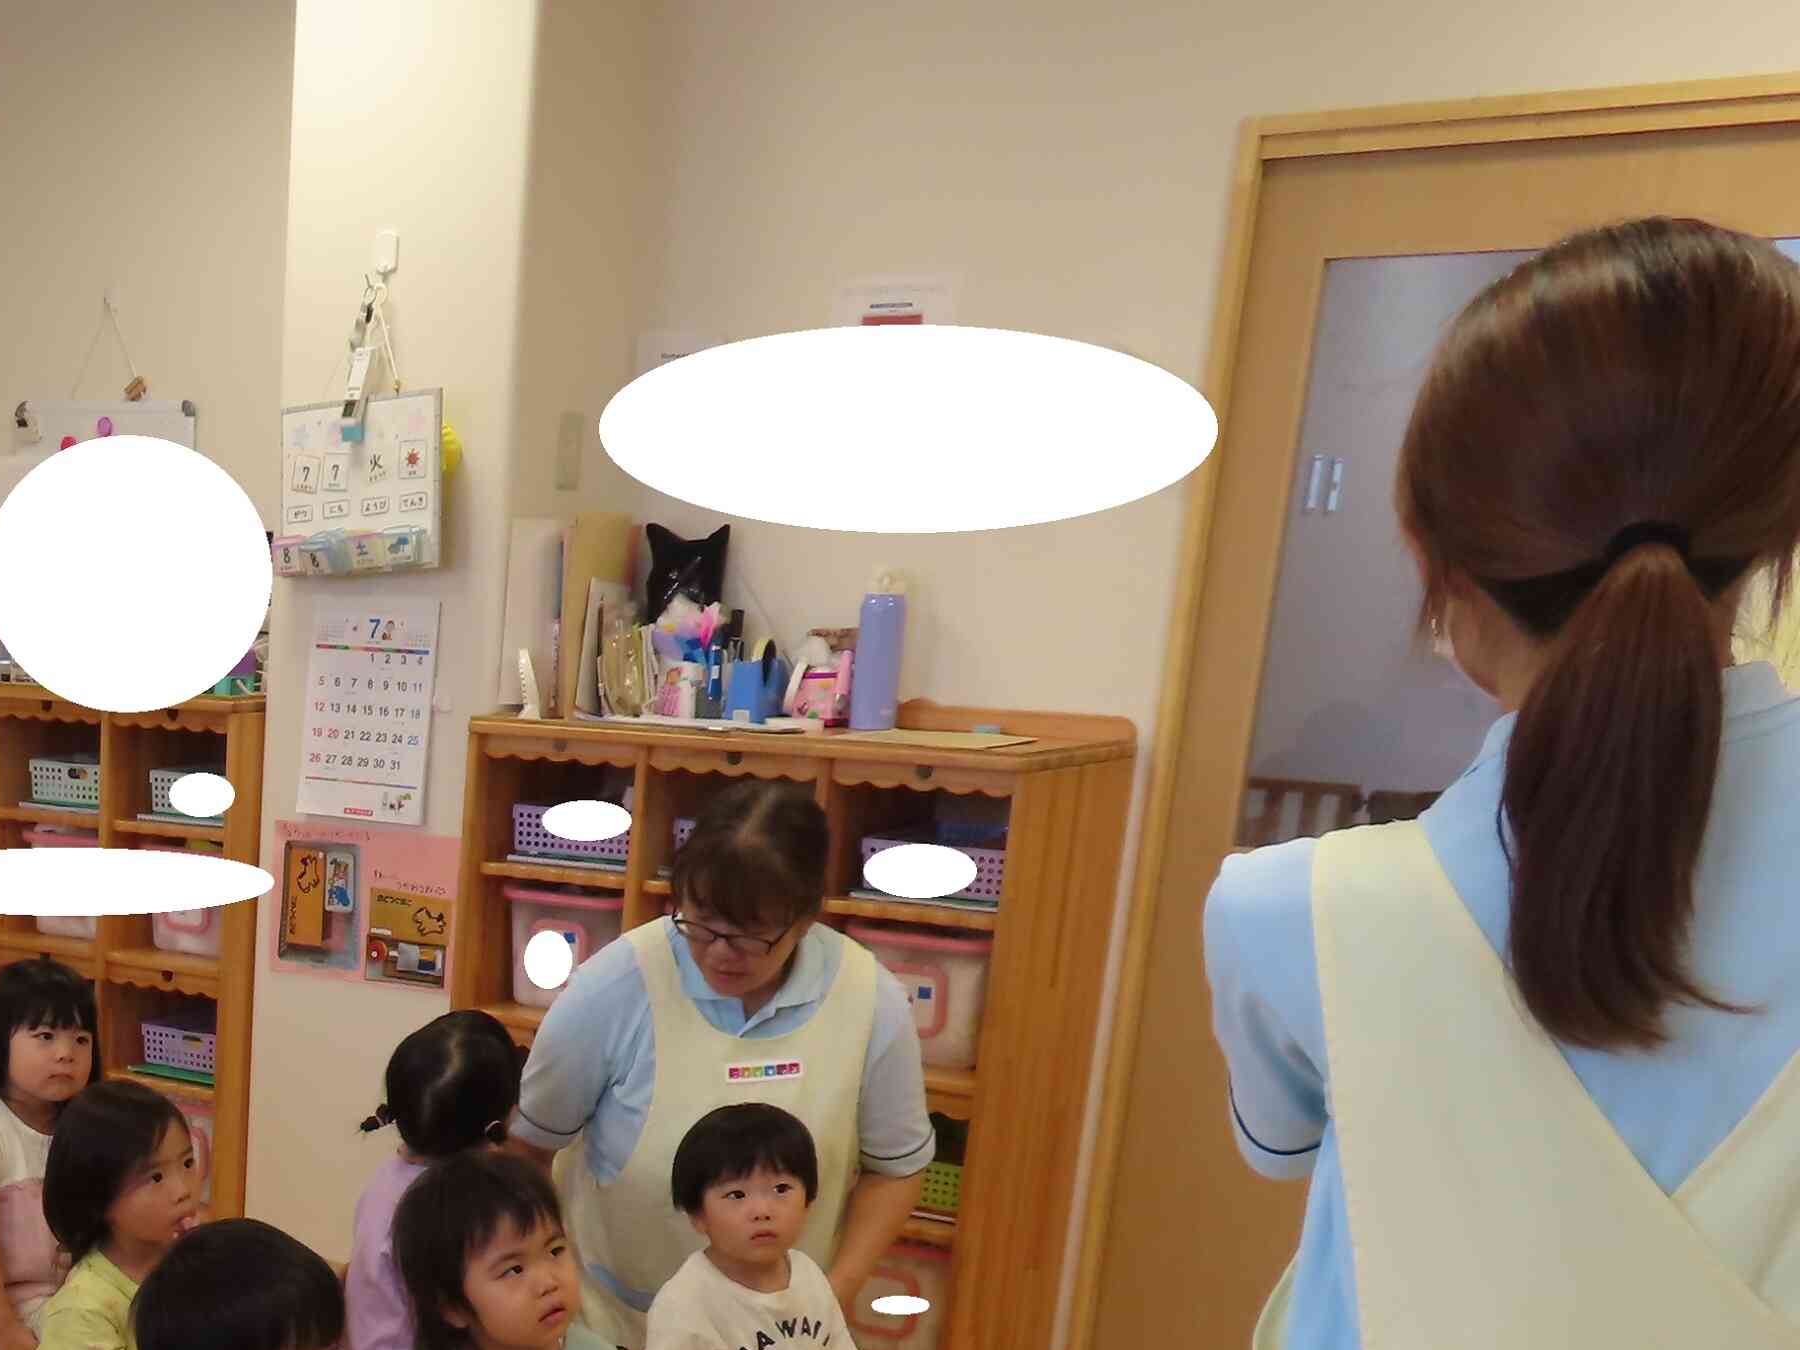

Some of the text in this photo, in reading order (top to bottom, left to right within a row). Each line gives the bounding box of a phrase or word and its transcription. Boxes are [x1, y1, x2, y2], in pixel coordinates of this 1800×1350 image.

[370, 454, 383, 472] 火
[302, 465, 310, 482] 7
[332, 464, 340, 481] 7
[365, 501, 387, 513] ようび
[369, 618, 381, 639] 7
[397, 681, 407, 691] 10
[413, 683, 422, 692] 11
[315, 702, 420, 719] 12 13 14 15 16 17 18
[312, 727, 419, 745] 19 20 21 22 23 24 25
[310, 752, 400, 770] 26 27 28 29 30 31
